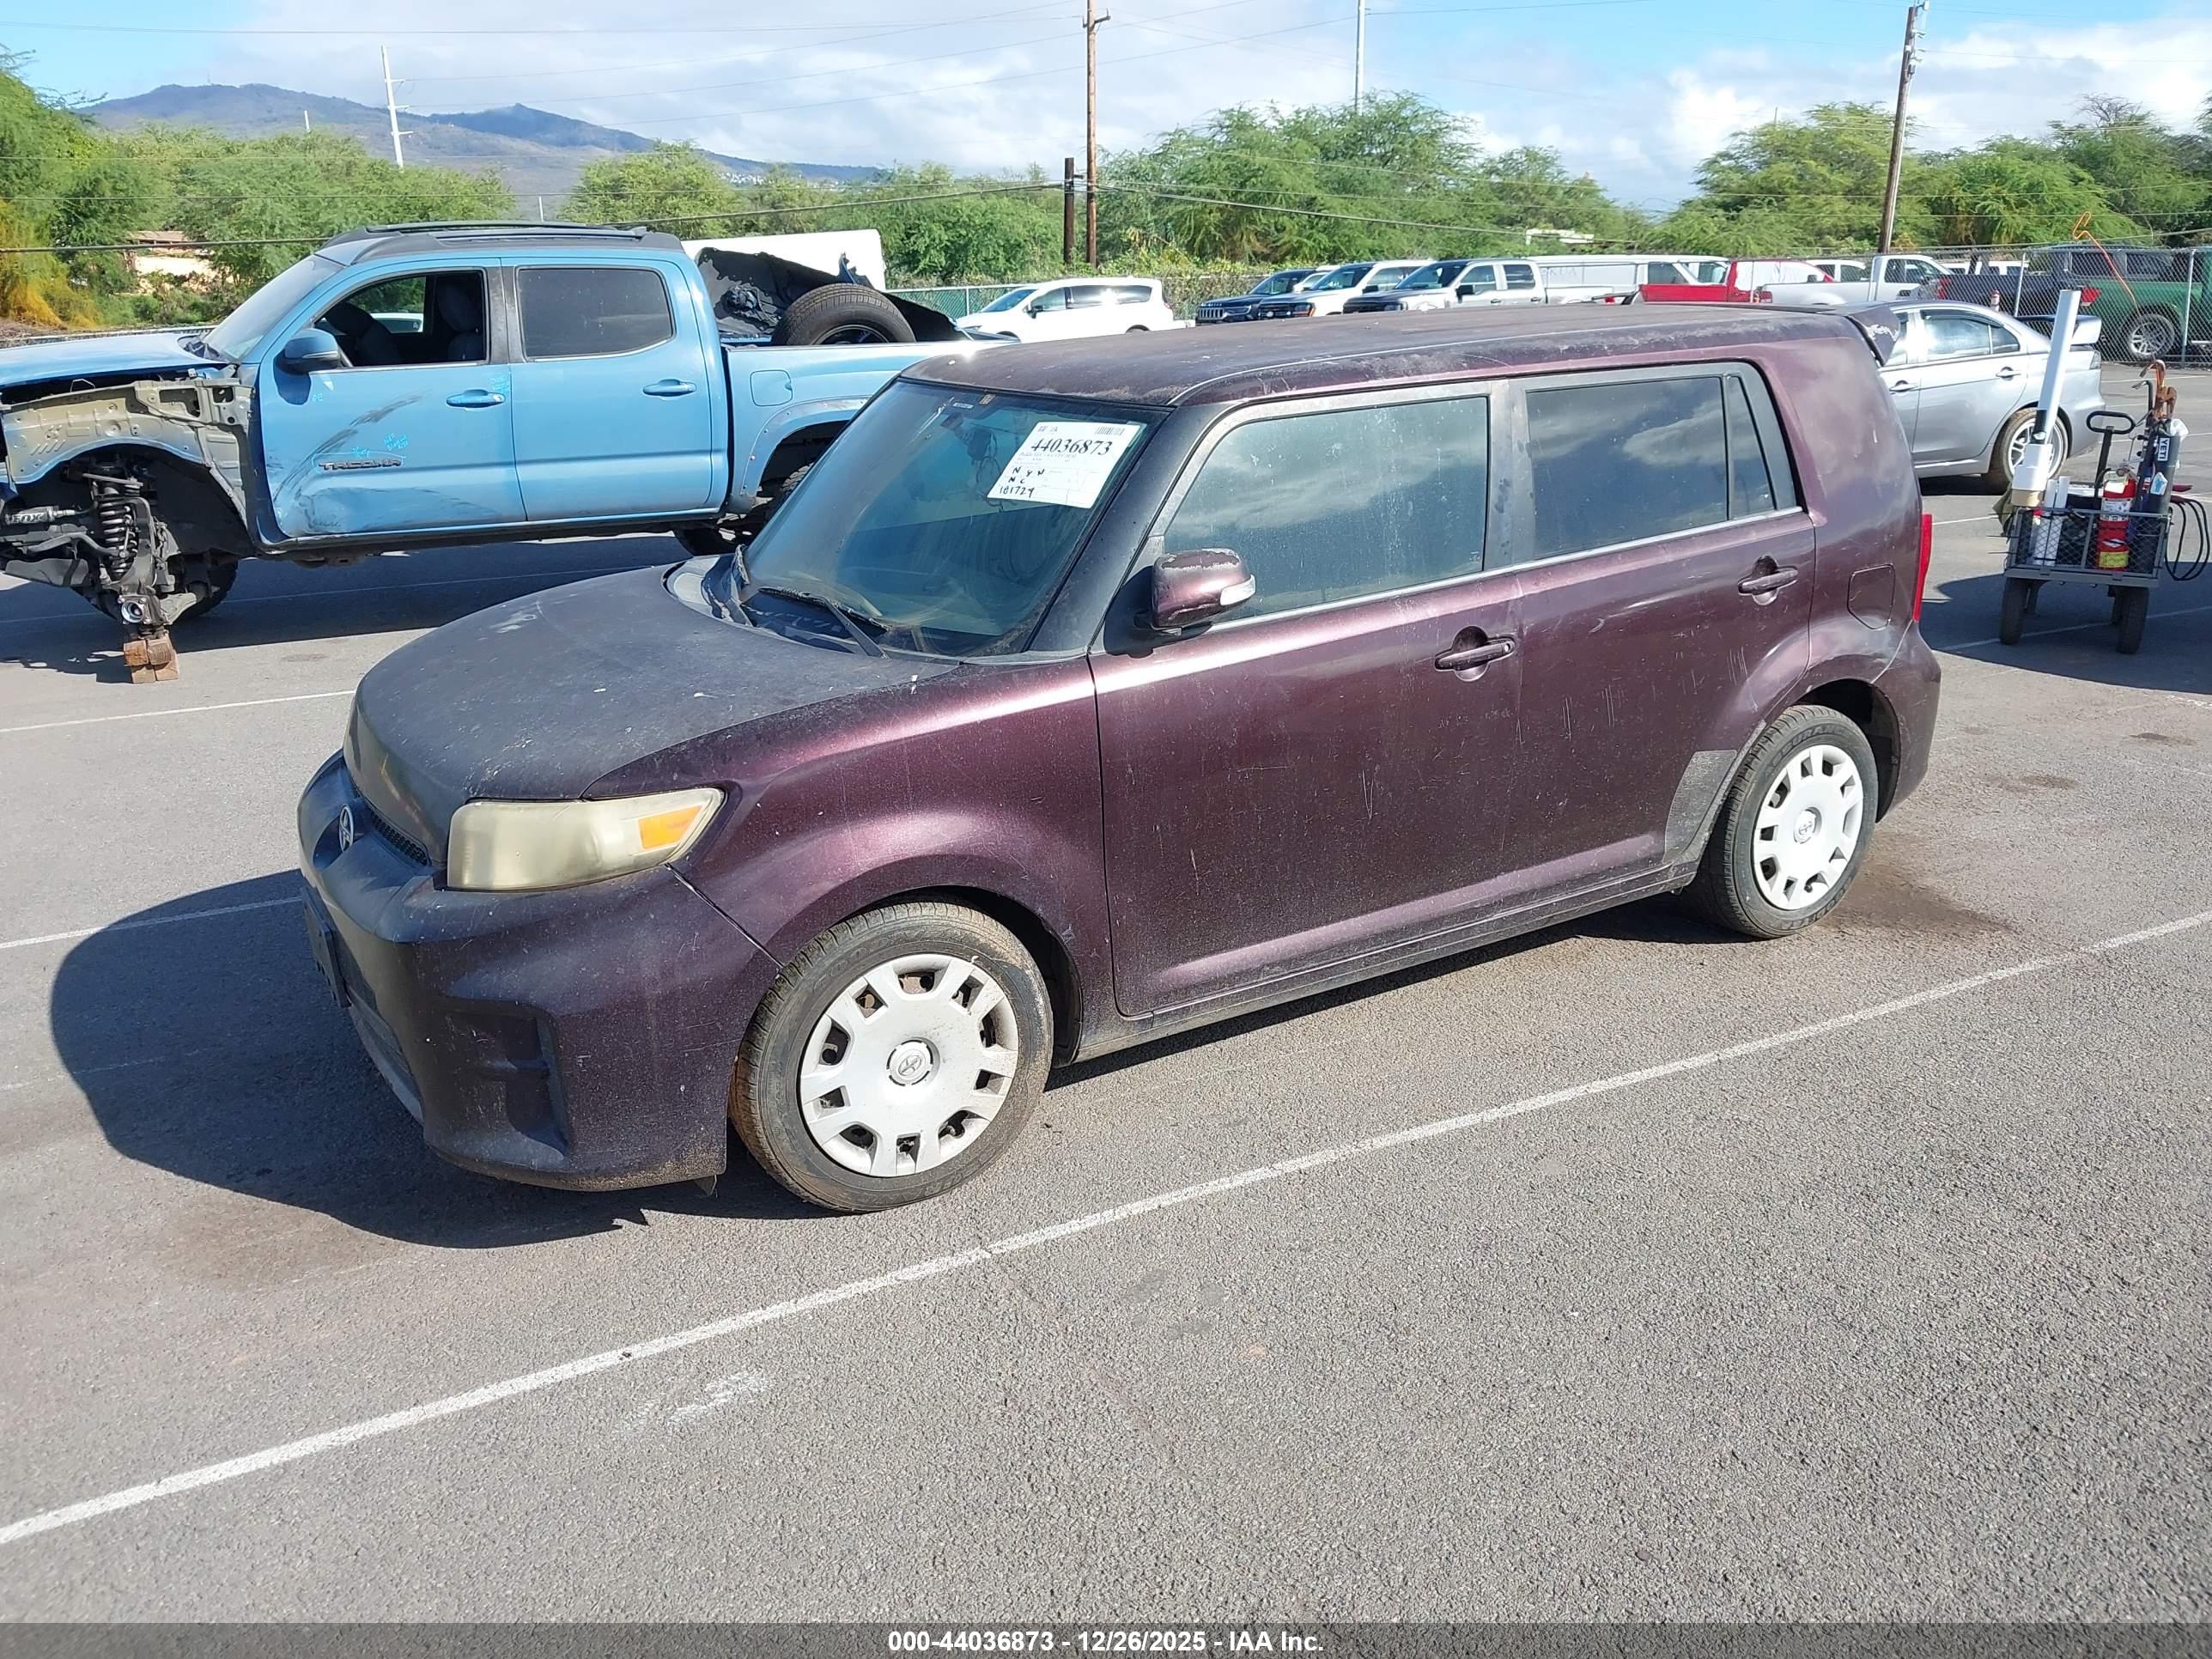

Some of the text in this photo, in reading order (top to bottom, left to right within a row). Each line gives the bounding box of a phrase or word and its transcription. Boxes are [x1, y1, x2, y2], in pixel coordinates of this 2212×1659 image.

[1030, 438, 1113, 456] 44036873
[2159, 439, 2169, 459] YETI
[319, 459, 402, 471] TACOMA
[12, 514, 42, 524] FOX
